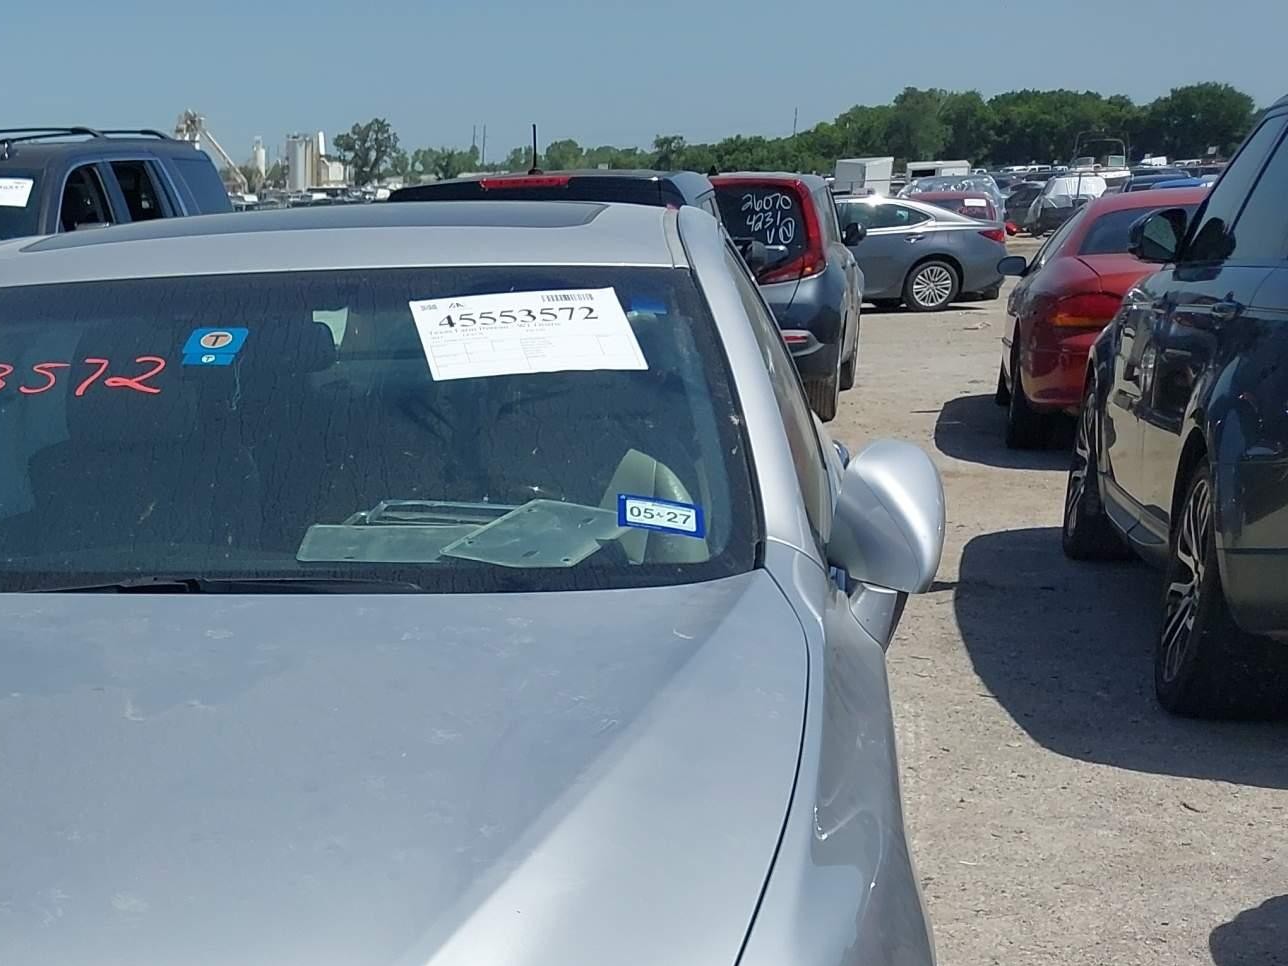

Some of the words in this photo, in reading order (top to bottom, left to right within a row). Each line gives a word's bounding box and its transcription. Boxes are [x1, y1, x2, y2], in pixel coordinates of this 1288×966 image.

[741, 193, 792, 212] 26070
[746, 210, 781, 232] 4231
[438, 306, 599, 328] 45553572
